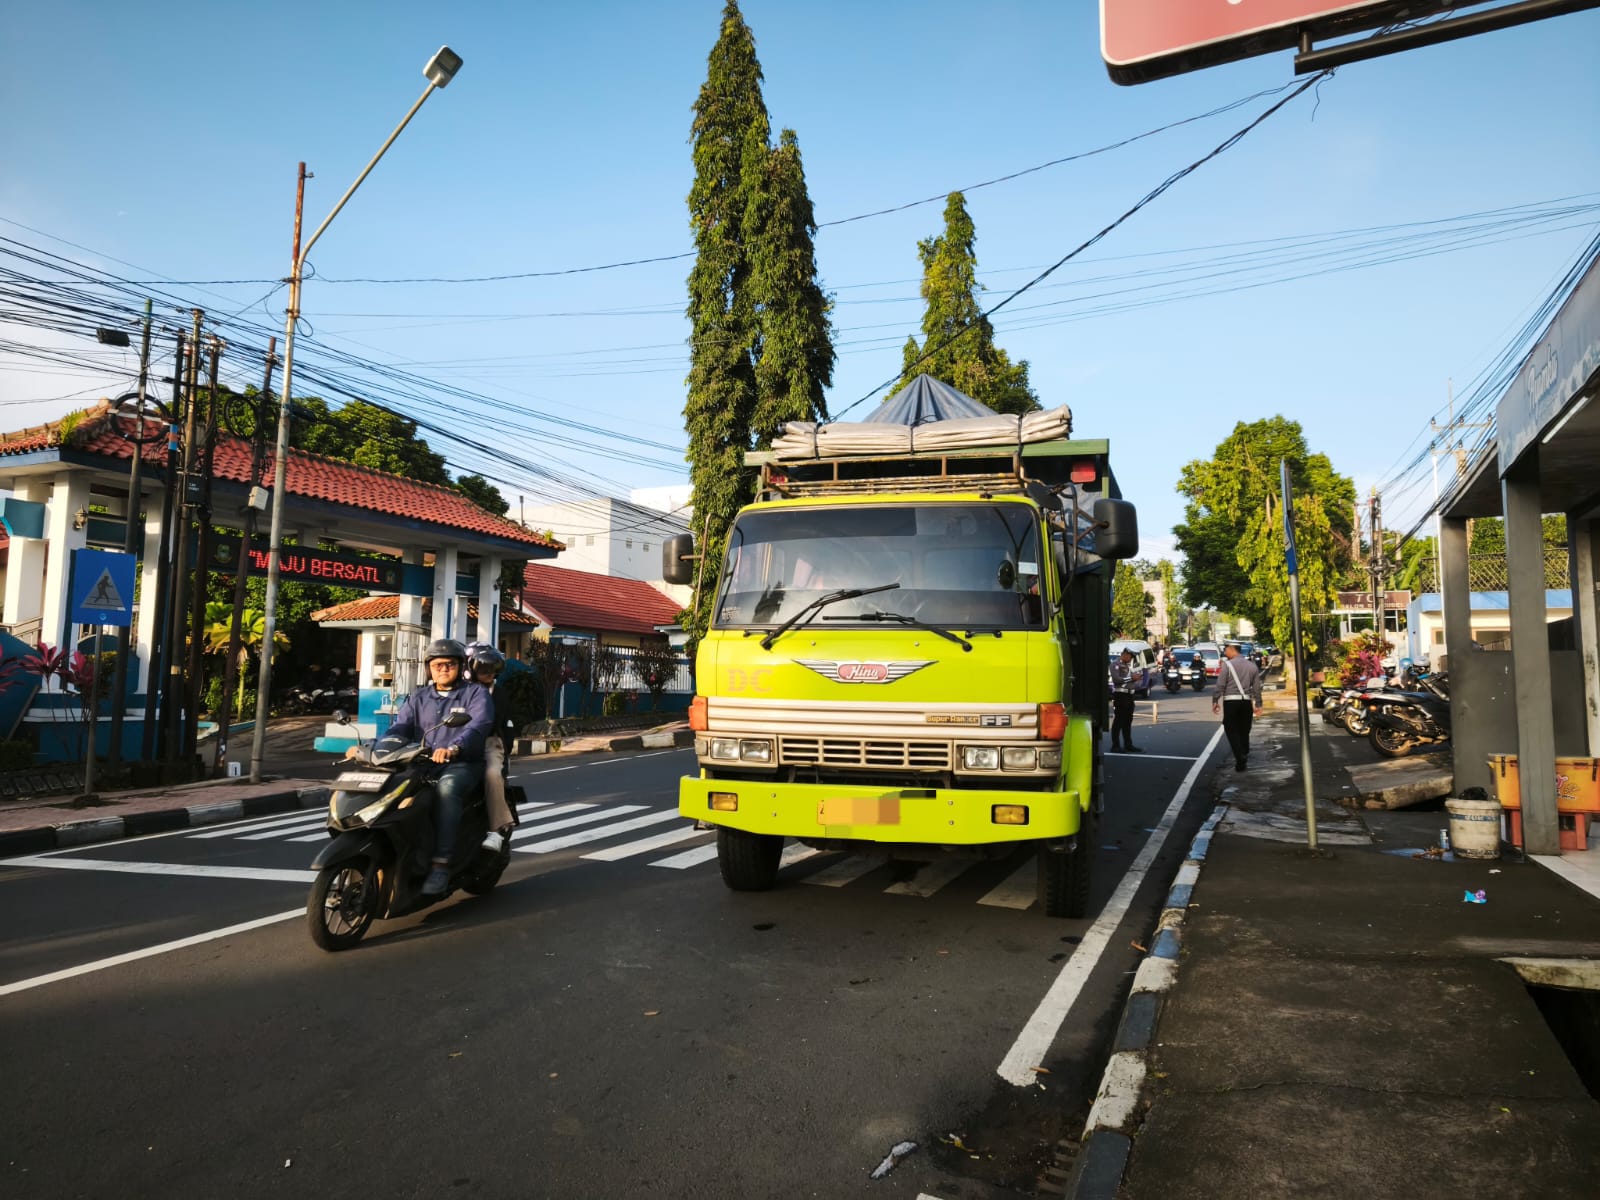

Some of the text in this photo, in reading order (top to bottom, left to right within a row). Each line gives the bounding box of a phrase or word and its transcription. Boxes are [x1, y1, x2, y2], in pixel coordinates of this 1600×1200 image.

[727, 668, 773, 692] DC
[846, 663, 880, 680] Hino
[981, 715, 1010, 726] FF
